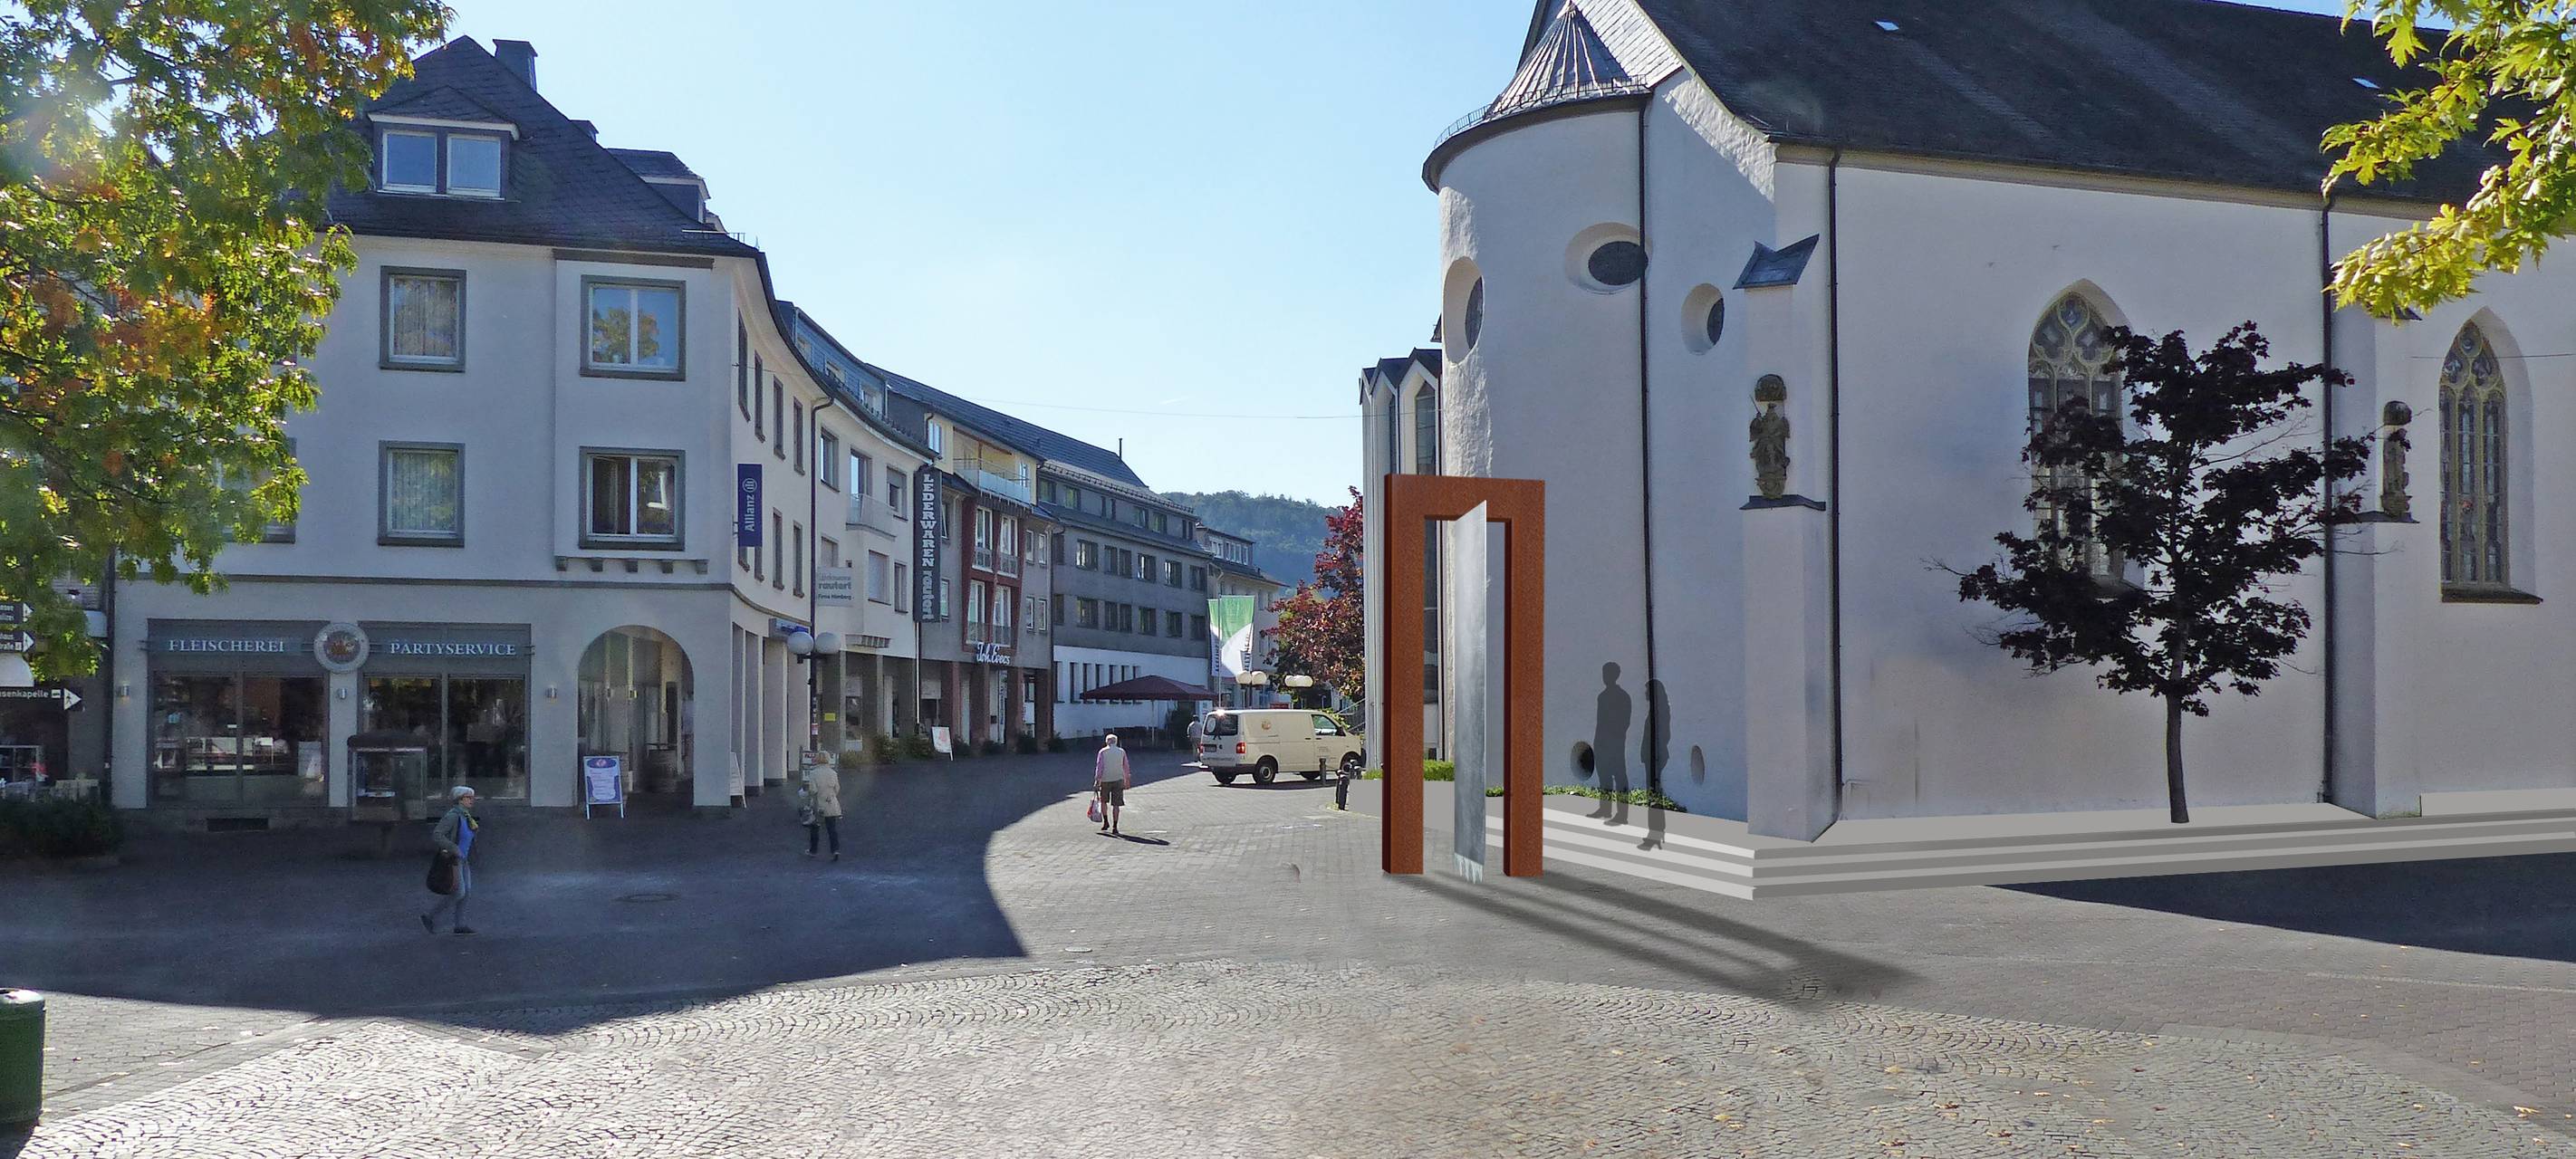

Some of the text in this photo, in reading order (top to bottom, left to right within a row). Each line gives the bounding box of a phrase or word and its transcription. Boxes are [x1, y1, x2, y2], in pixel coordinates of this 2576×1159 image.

[745, 495, 755, 532] Allianz
[920, 474, 937, 567] LEDERWAREN
[169, 639, 284, 653] FLEISCHEREI
[390, 642, 516, 656] PARTYSERVICE
